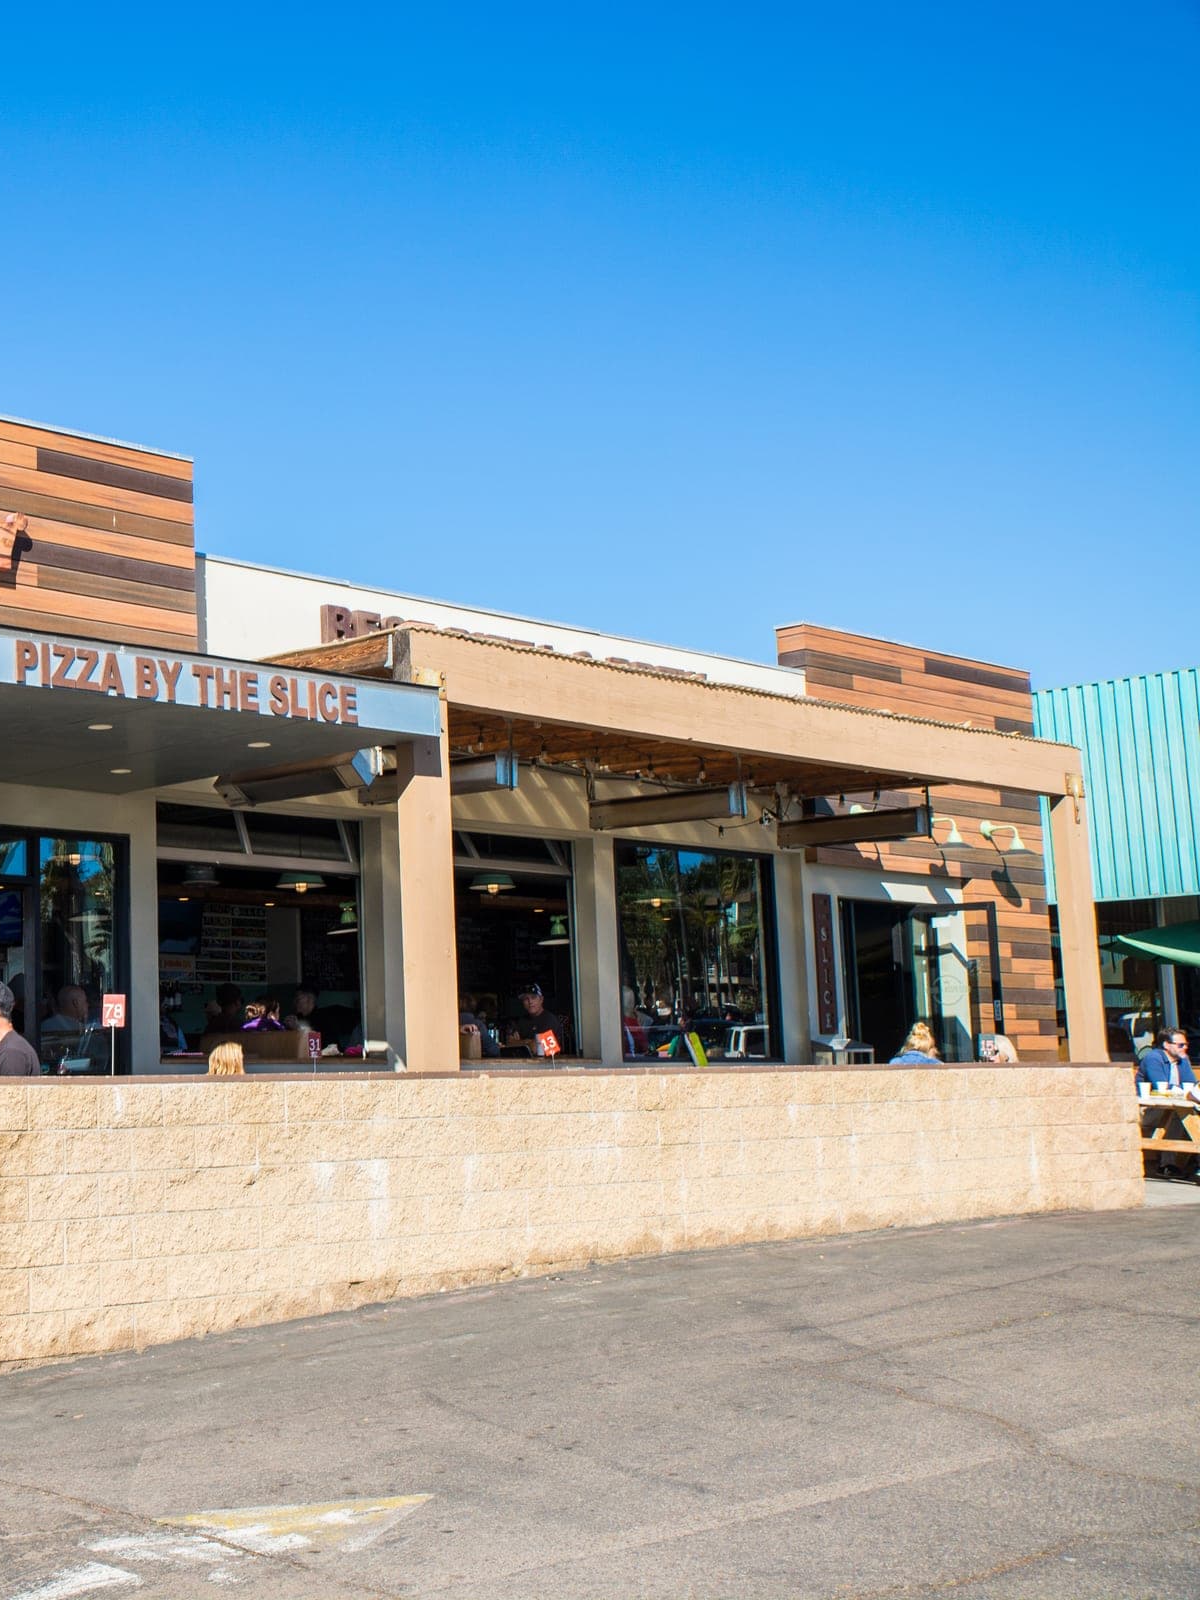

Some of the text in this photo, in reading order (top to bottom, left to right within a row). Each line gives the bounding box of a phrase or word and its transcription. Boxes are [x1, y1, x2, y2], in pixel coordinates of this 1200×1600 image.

[16, 640, 359, 724] PIZZA BY THE SLICE
[103, 1003, 122, 1019] 78
[309, 1038, 321, 1051] 31
[541, 1036, 557, 1050] 13
